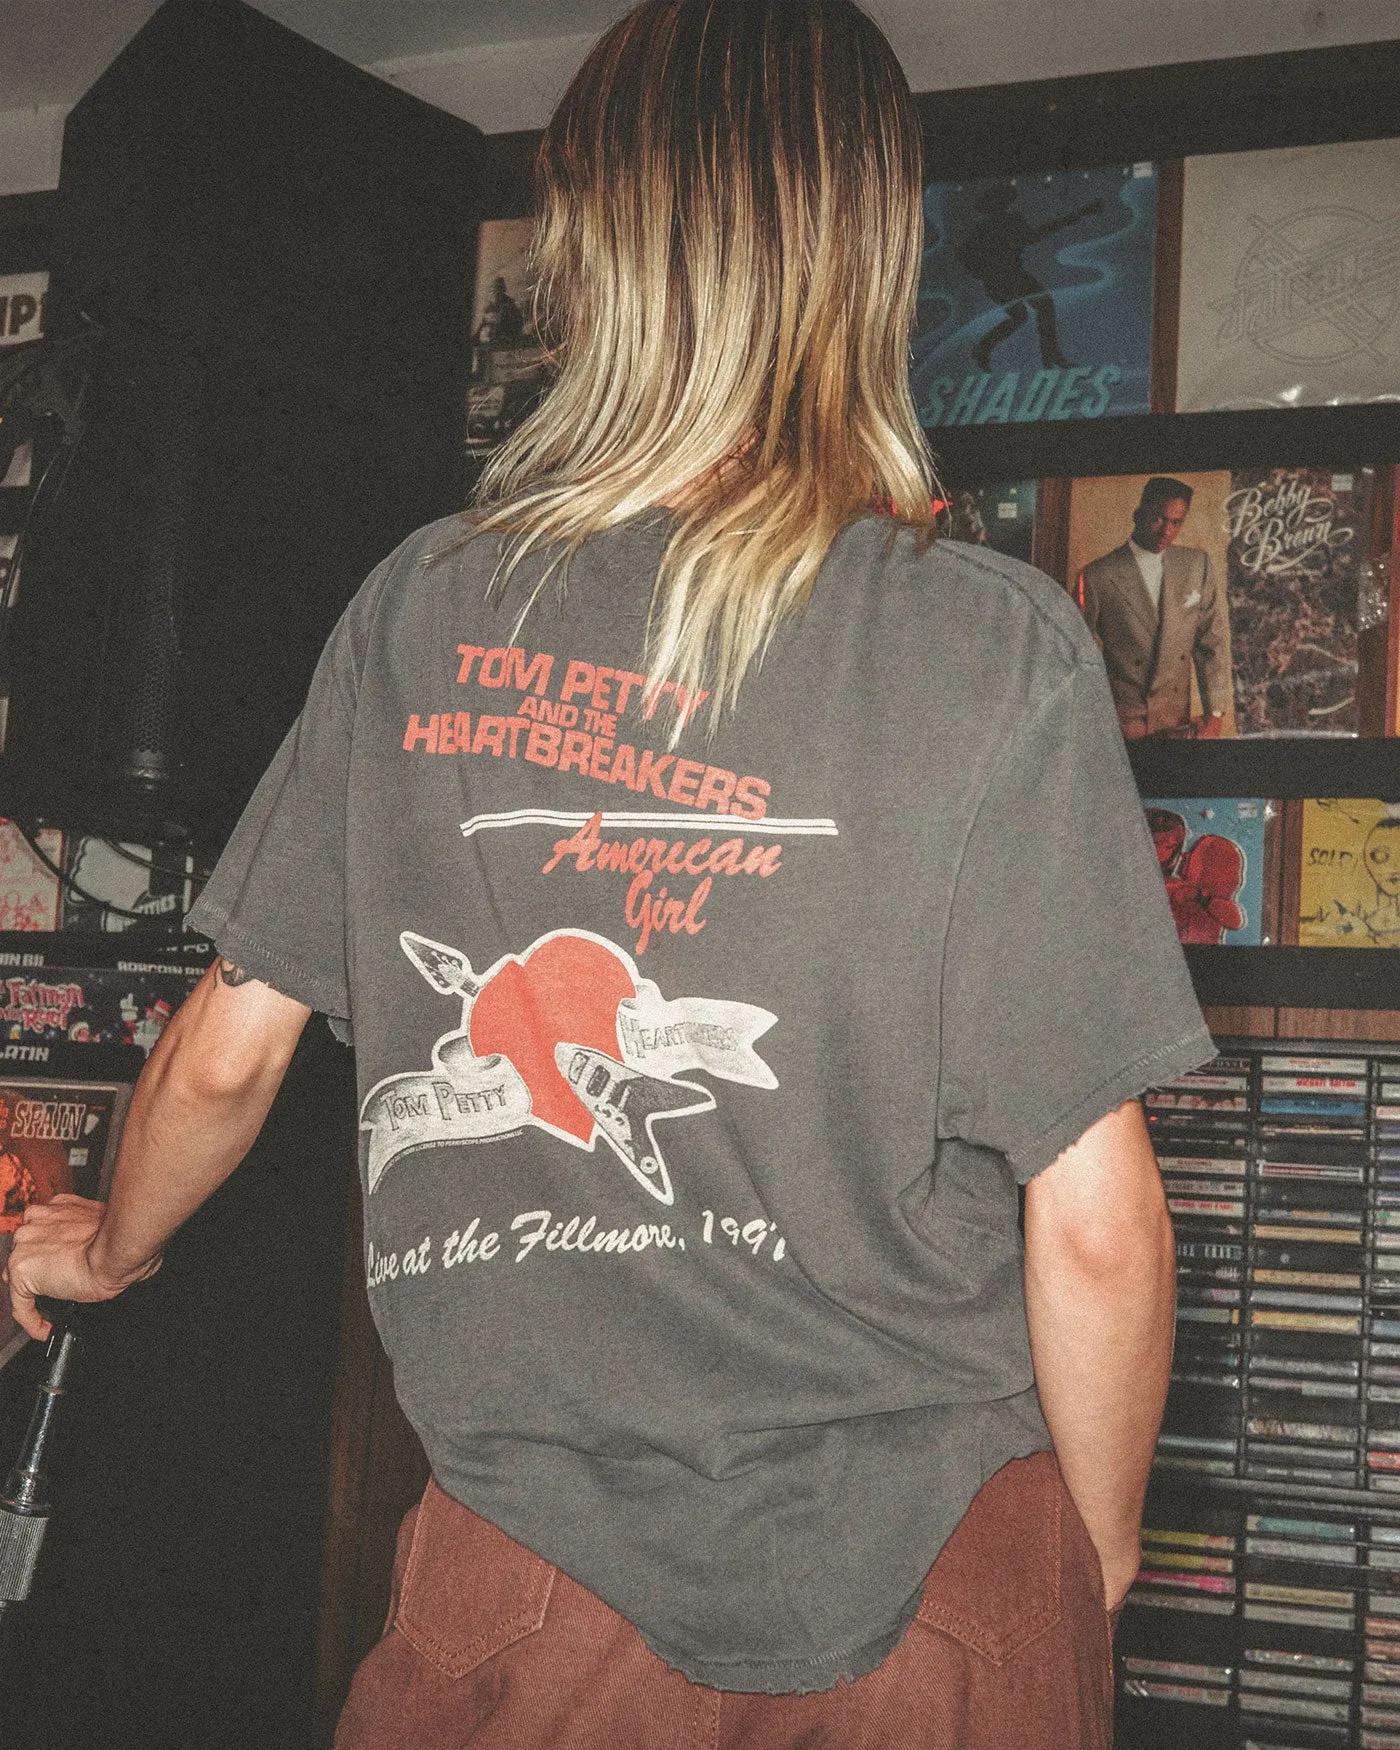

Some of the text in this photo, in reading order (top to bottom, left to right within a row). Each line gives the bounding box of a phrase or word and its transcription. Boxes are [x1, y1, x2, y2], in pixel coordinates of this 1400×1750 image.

[919, 363, 1122, 428] SHADES
[1222, 480, 1333, 537] Bobby
[1240, 518, 1354, 572] Brown
[456, 643, 711, 728] TOM PETTY
[517, 696, 618, 738] AND THE
[402, 712, 771, 821] HEARTBREAKERS
[542, 811, 782, 876] American
[625, 869, 713, 955] Girl
[380, 1081, 507, 1131] TOM PETTY
[366, 1241, 399, 1288] Live
[402, 1236, 431, 1275] at
[442, 1217, 501, 1269] the
[510, 1209, 685, 1262] Fillmore,
